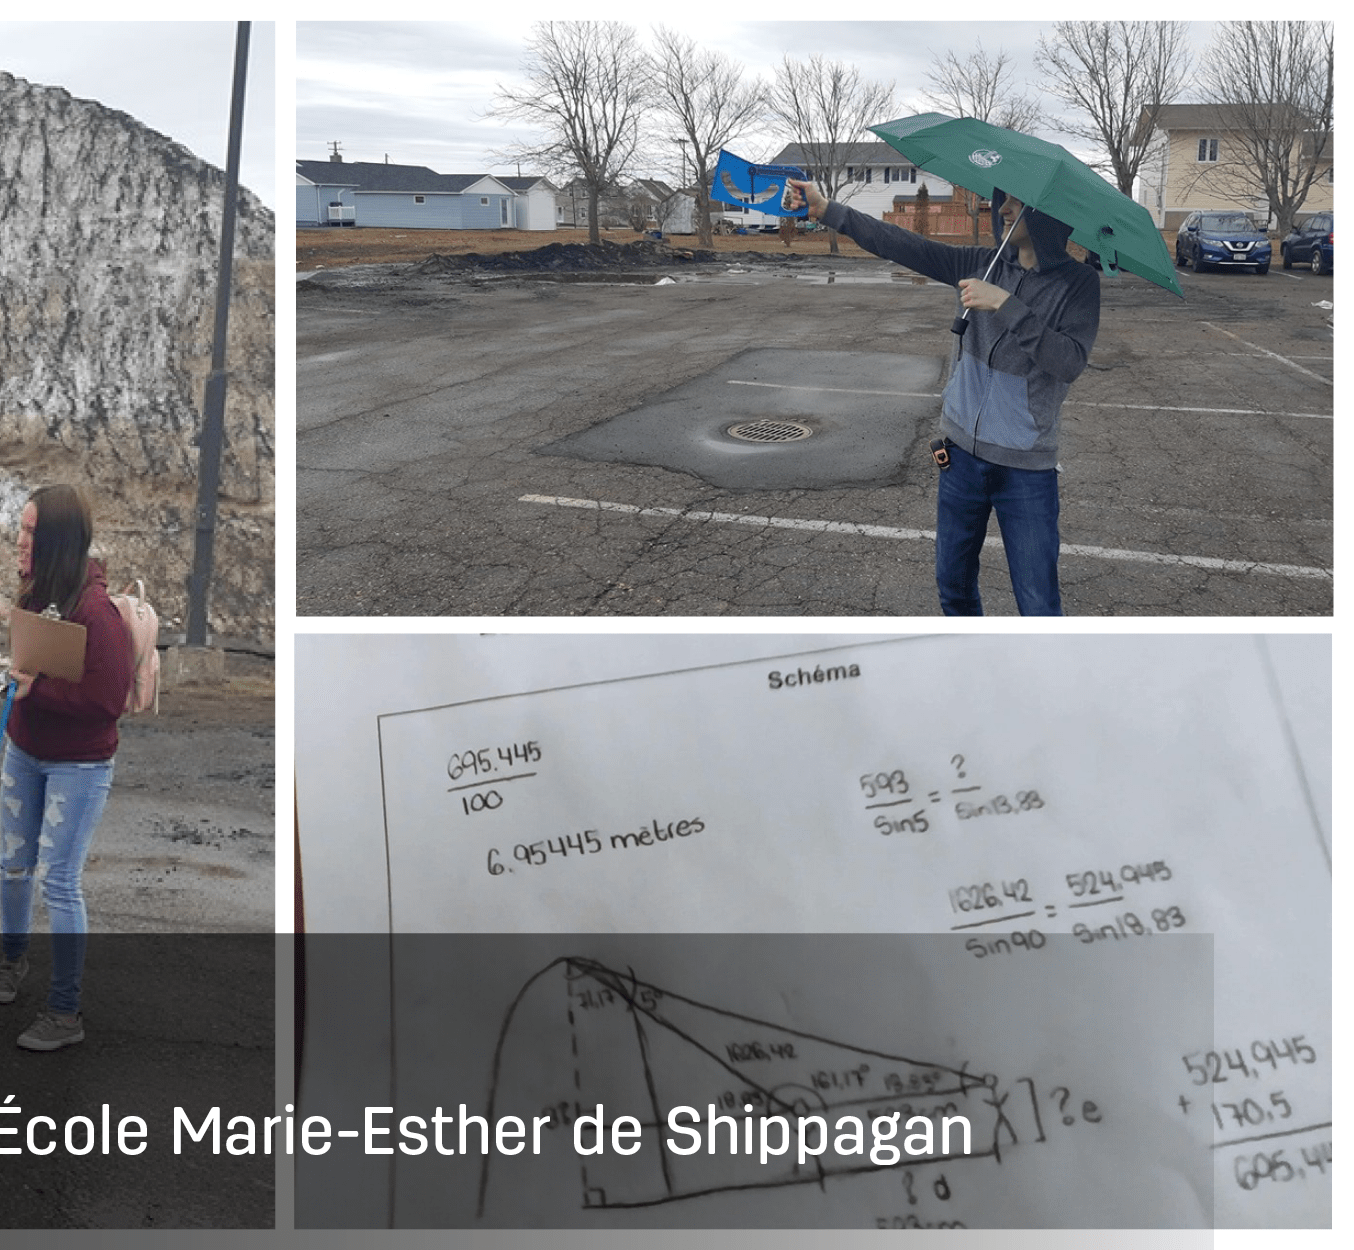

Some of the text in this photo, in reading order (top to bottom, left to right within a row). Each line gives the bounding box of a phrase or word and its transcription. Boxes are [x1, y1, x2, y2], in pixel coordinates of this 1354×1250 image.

[767, 663, 861, 690] Schéma
[447, 740, 543, 780] 695.445
[859, 769, 910, 798] 593
[462, 789, 504, 816] 100
[487, 816, 706, 876] 6.95445 mètres
[1181, 1035, 1317, 1086] 524,945
